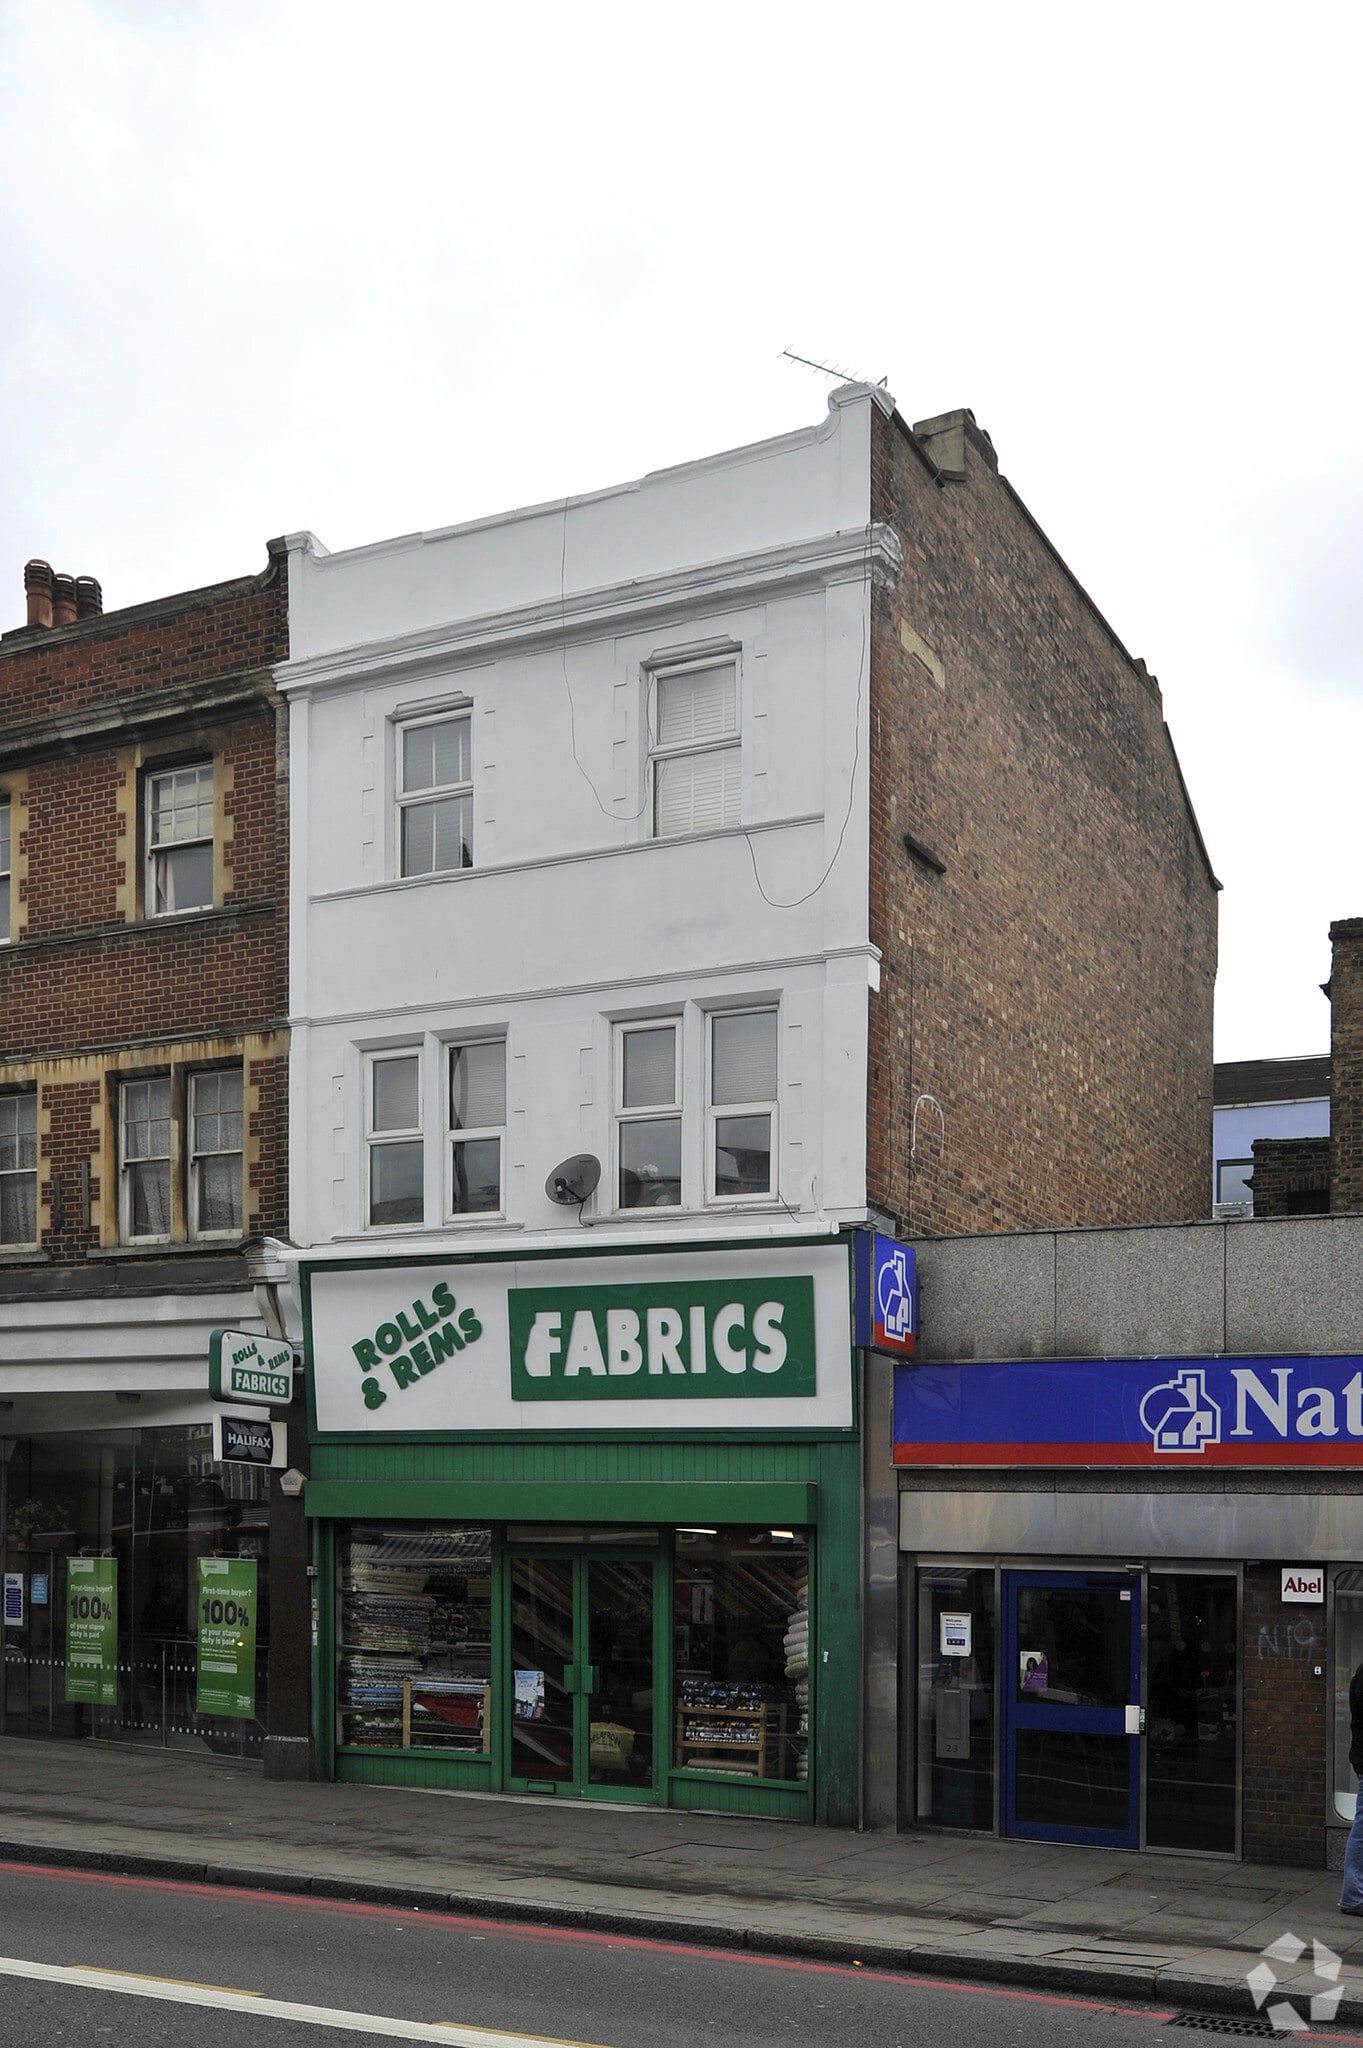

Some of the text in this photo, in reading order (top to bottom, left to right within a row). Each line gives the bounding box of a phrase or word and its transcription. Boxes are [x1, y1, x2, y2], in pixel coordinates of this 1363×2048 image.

[352, 1282, 456, 1373] ROLLS
[524, 1301, 788, 1377] FABRICS
[232, 1343, 290, 1371] ROLLS & REMS
[361, 1308, 482, 1410] & REMS
[235, 1371, 286, 1395] FABRICS
[1230, 1368, 1363, 1437] Nat
[228, 1433, 271, 1449] HALIFAX
[202, 1586, 252, 1598] First-time buyer?
[1284, 1577, 1321, 1593] Abel
[70, 1595, 112, 1620] 100%
[202, 1599, 249, 1627] 100%
